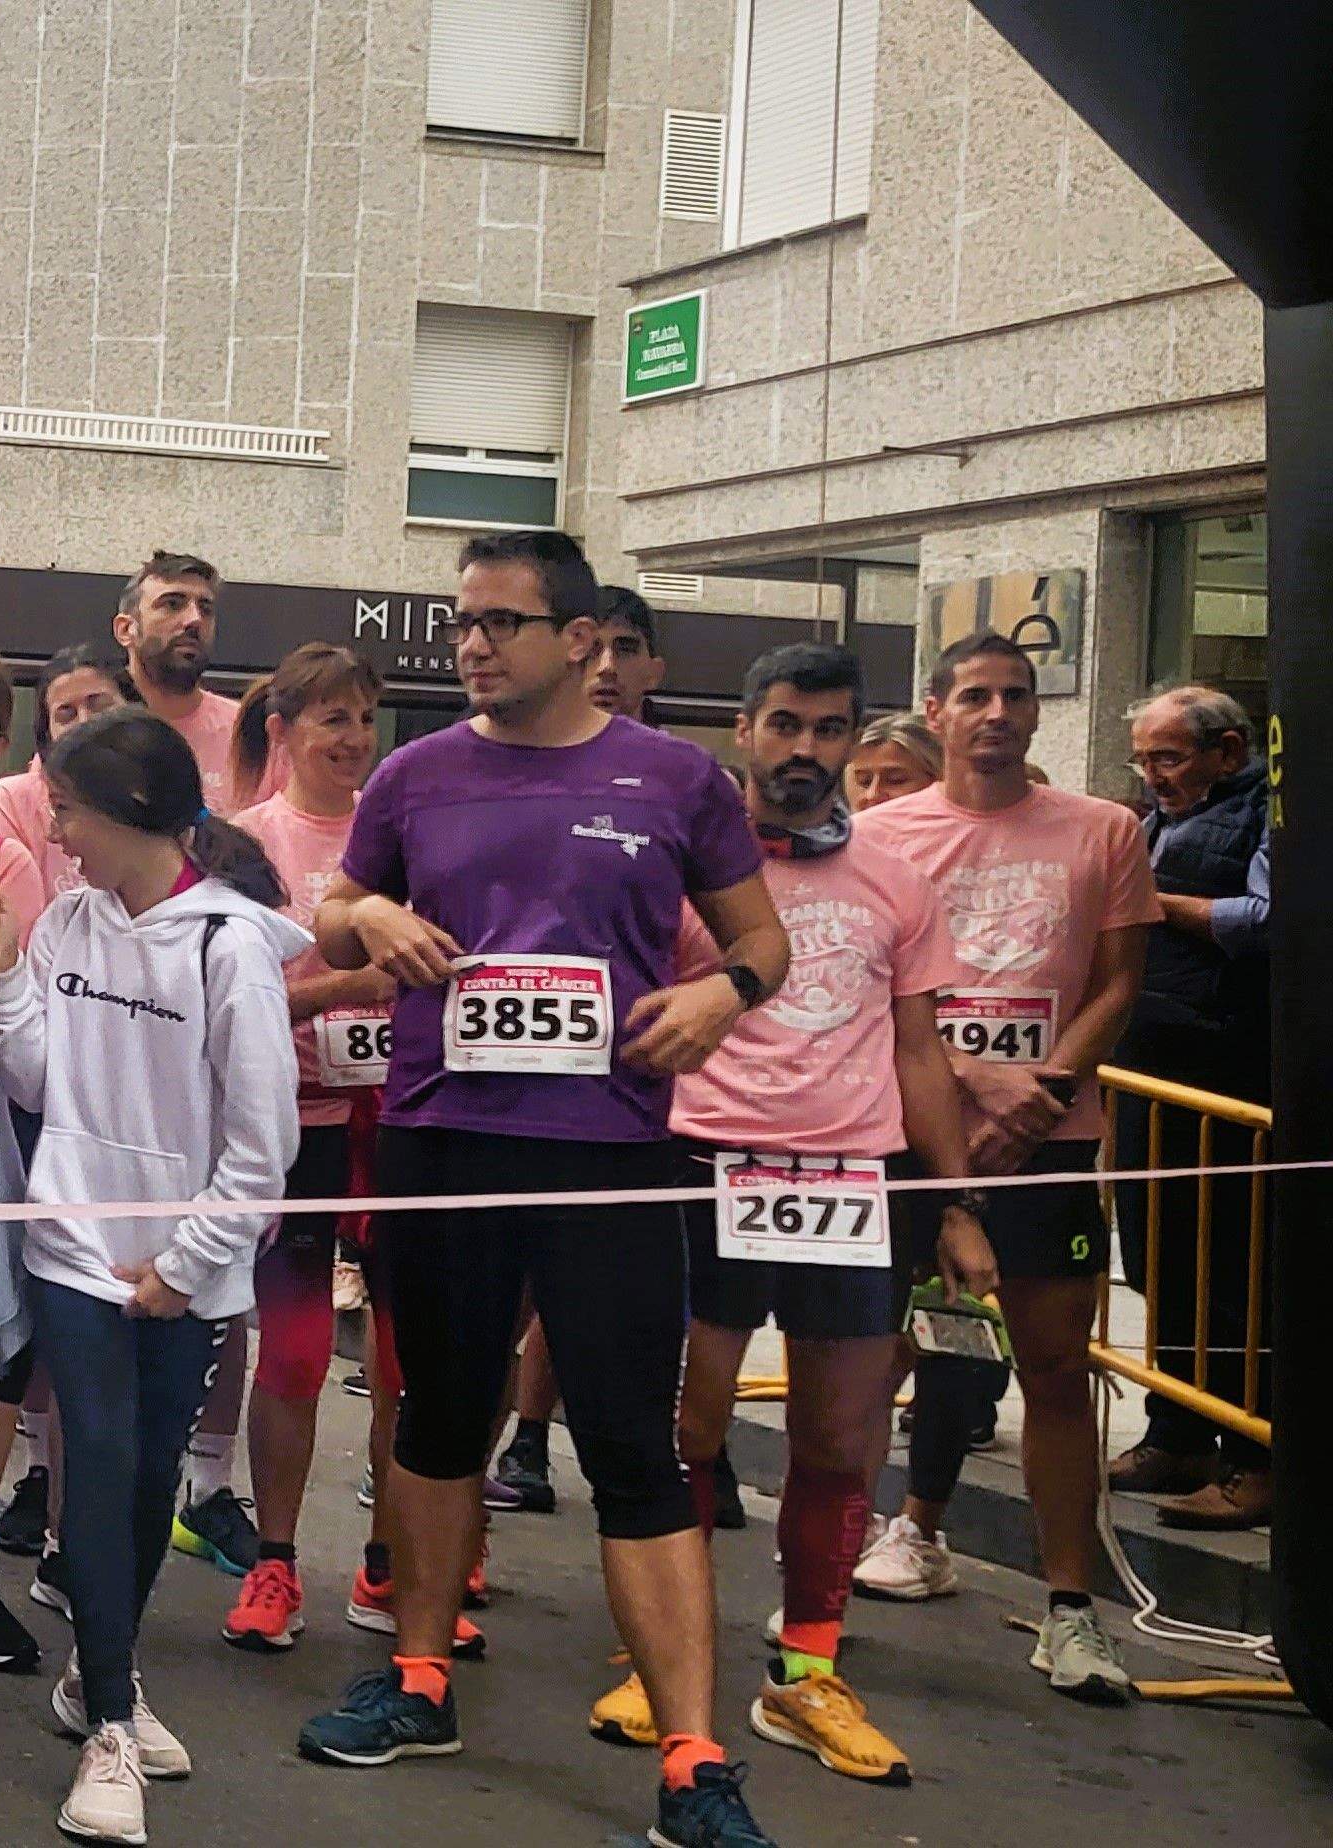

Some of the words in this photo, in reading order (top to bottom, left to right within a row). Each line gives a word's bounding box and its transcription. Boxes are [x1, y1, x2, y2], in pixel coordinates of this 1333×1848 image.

[55, 972, 187, 1023] Champion
[459, 997, 599, 1042] 3855
[736, 1194, 874, 1237] 2677
